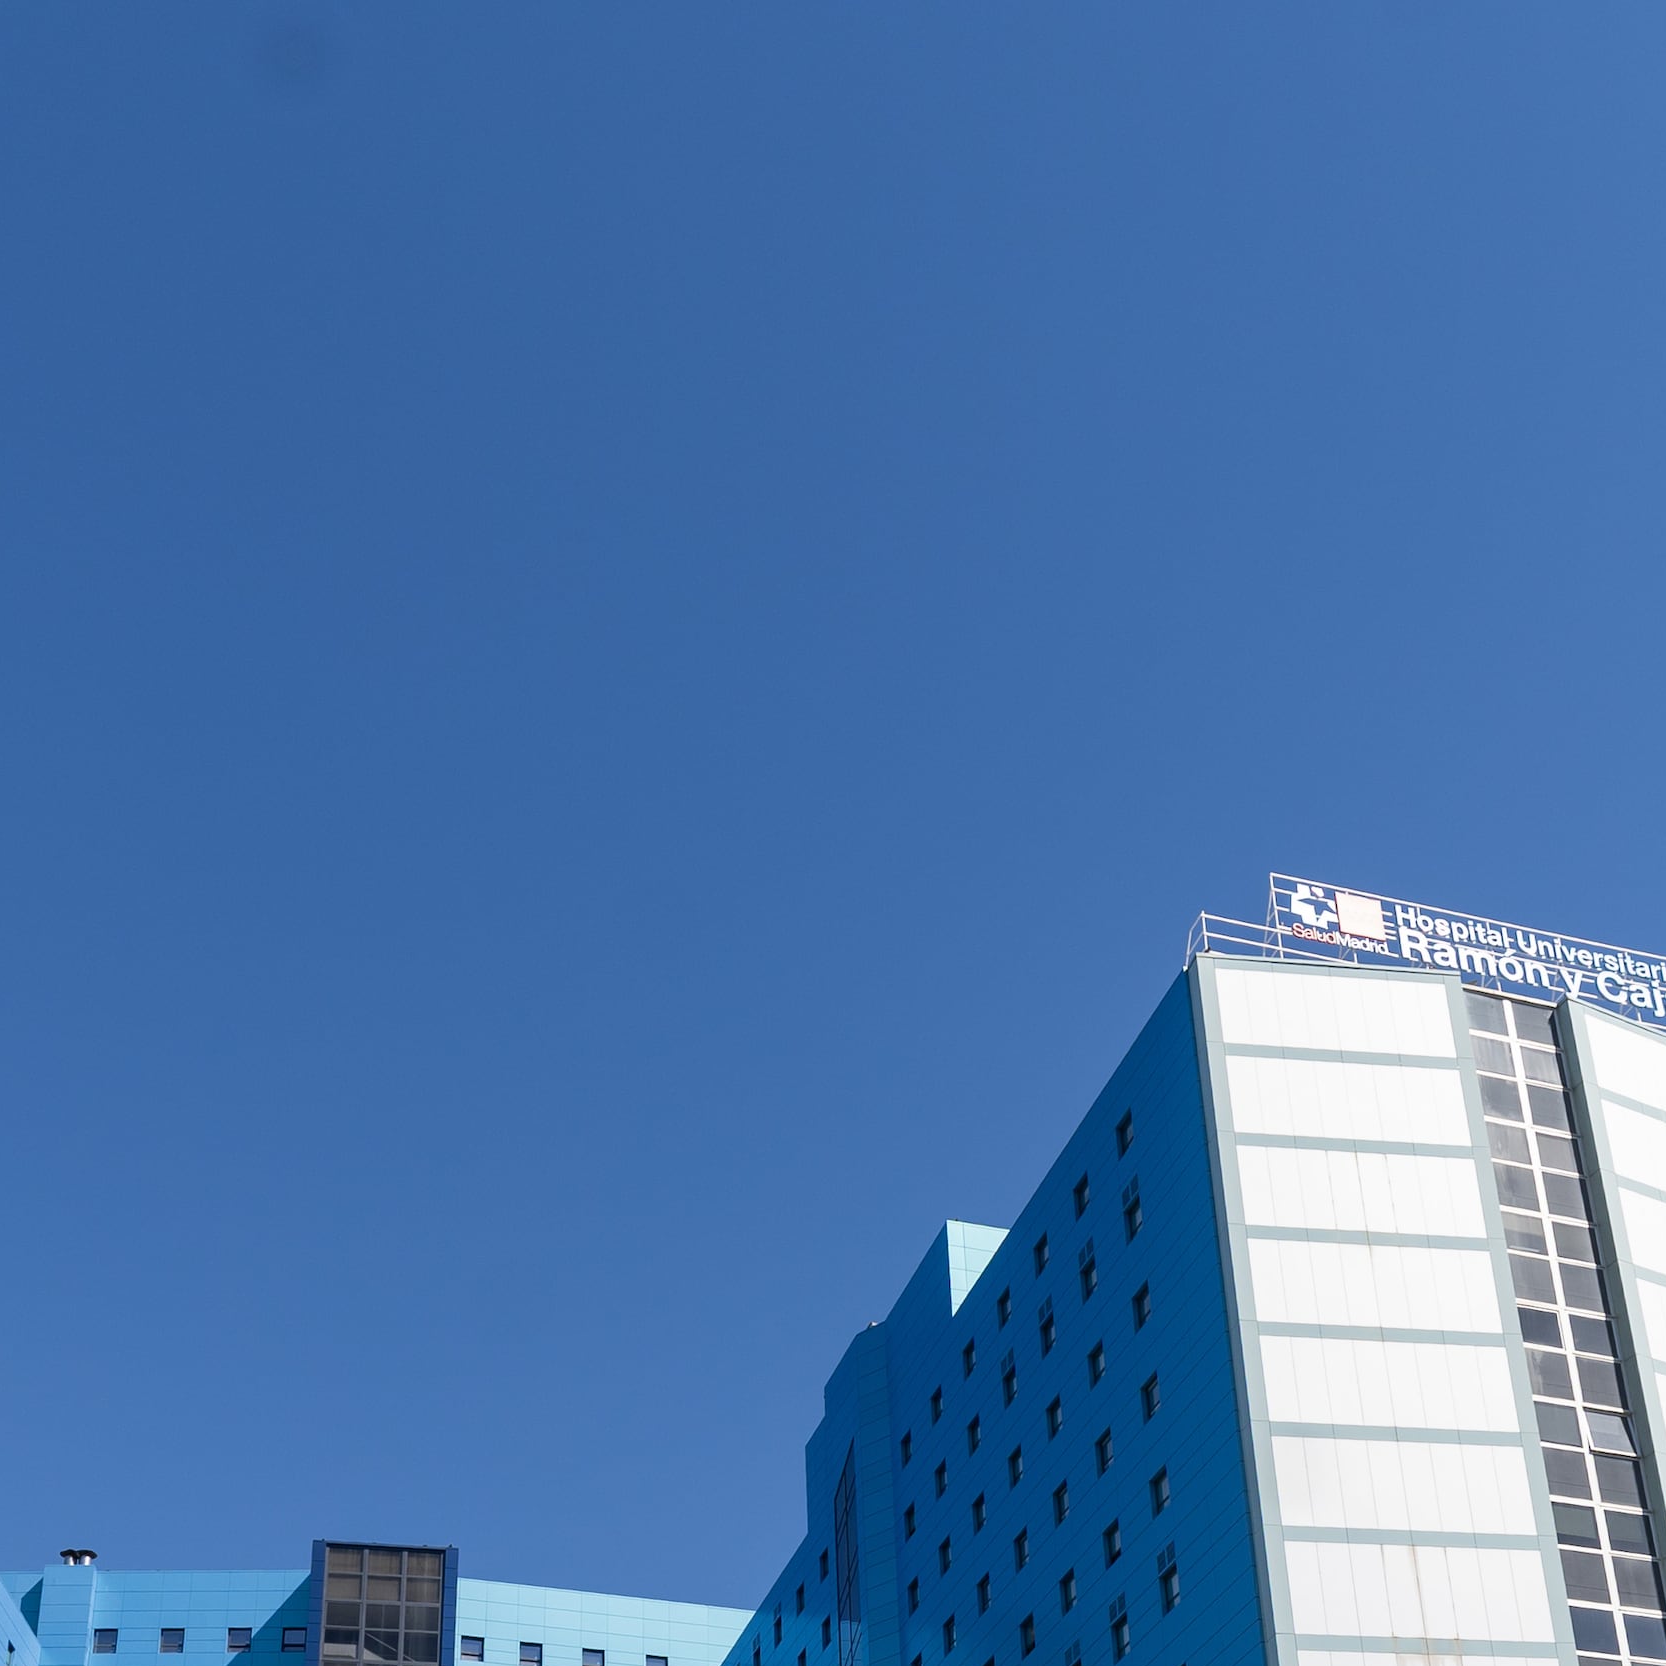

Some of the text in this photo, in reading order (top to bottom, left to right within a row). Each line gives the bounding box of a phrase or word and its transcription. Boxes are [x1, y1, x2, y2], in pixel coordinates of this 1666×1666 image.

[1395, 904, 1509, 948] Hospital
[1399, 926, 1551, 988] Ramón
[1559, 968, 1583, 999] y
